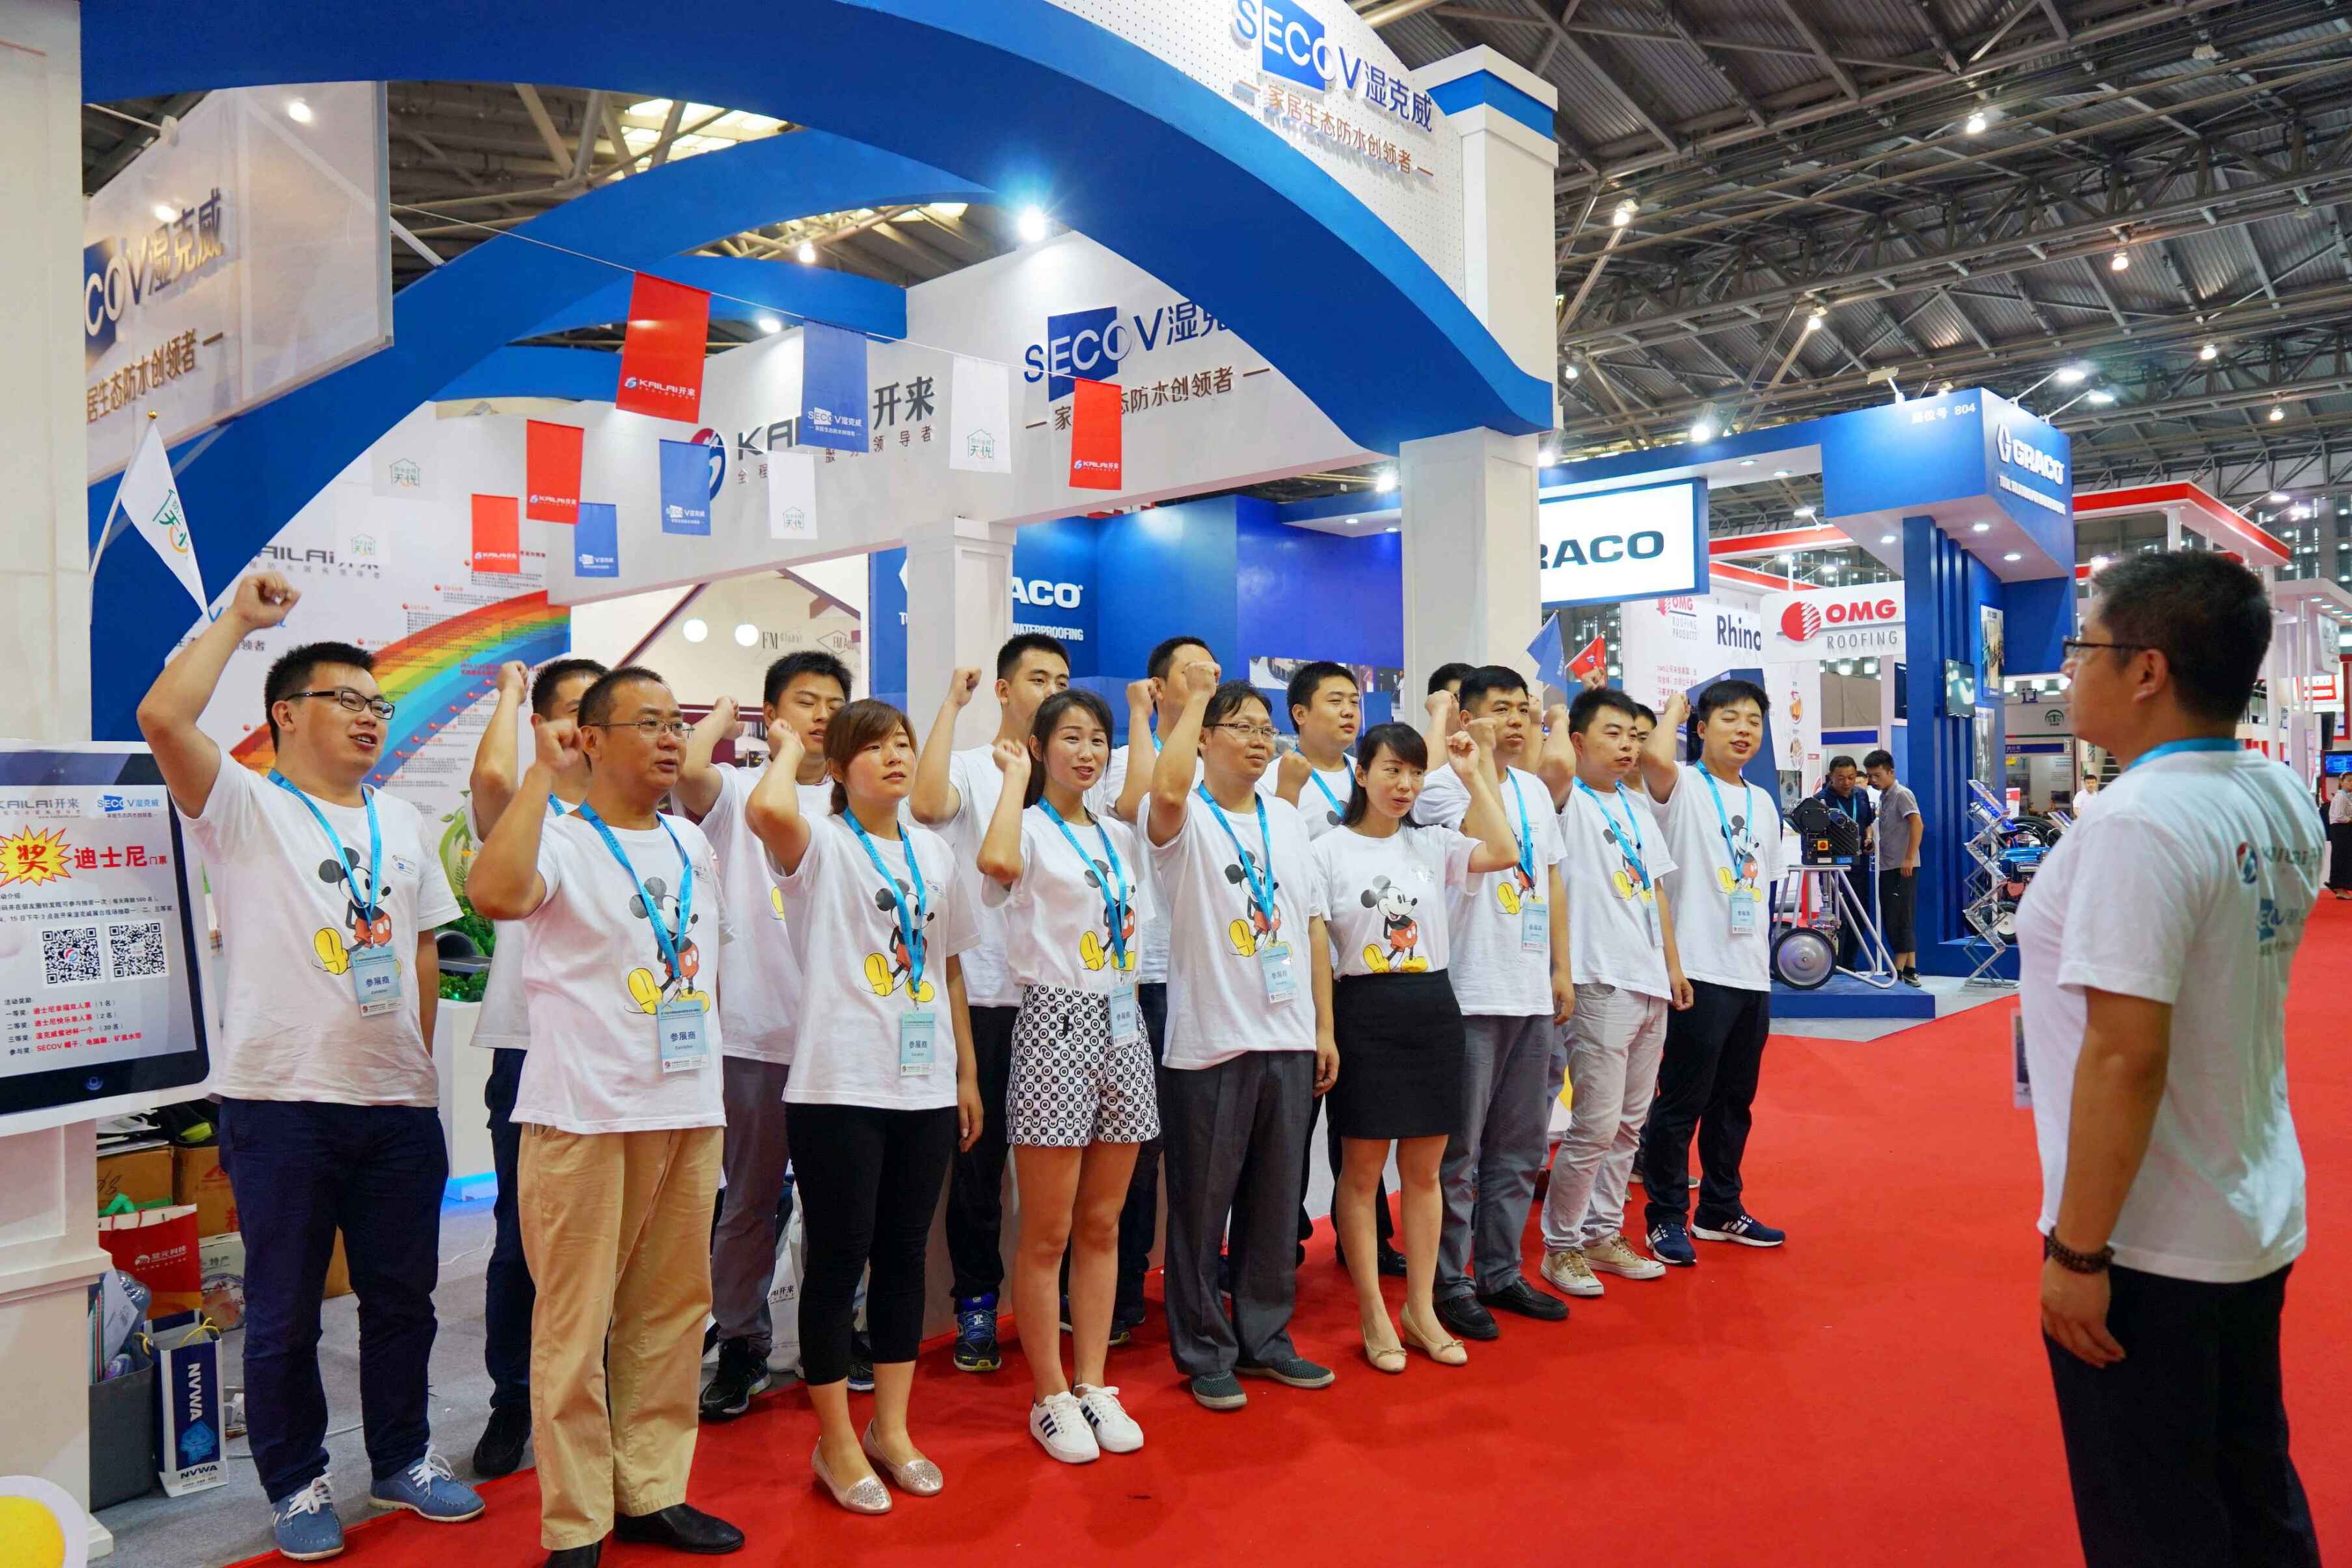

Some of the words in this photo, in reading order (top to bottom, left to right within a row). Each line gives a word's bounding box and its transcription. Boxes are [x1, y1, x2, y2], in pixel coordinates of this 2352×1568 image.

[1268, 85, 1411, 174] 家居生态防水创领者
[872, 377, 934, 430] 开来
[1954, 403, 1976, 416] 804
[2013, 438, 2064, 485] GRACO
[1826, 599, 1897, 623] OMG
[763, 632, 777, 649] FM
[1827, 631, 1898, 649] ROOFING
[55, 798, 79, 809] 开来
[16, 844, 49, 874] 奖
[365, 976, 390, 987] 参展商
[670, 1031, 696, 1042] 参展商
[37, 1043, 62, 1051] SECOV
[188, 1362, 203, 1422] NVWA
[180, 1465, 219, 1479] NVWA
